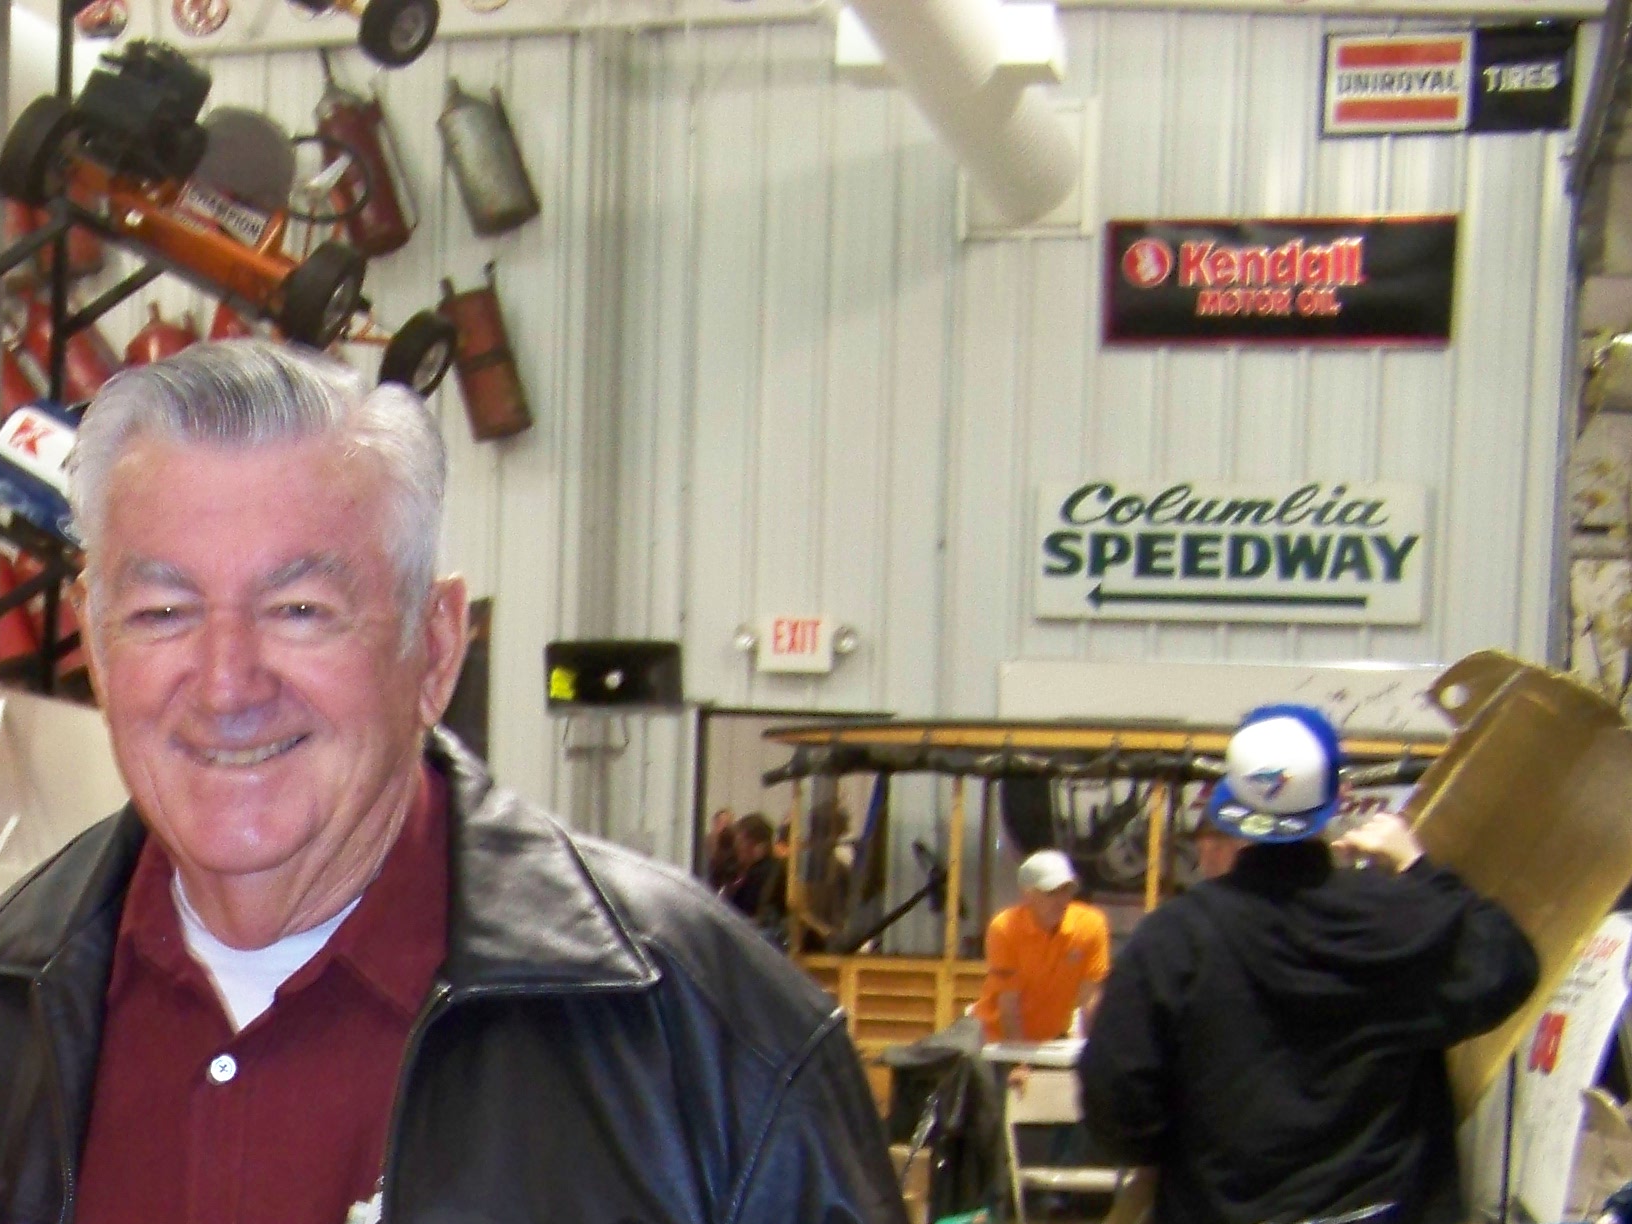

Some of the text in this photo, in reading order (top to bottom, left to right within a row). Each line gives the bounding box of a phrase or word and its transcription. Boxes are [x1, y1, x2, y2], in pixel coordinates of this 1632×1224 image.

[1336, 63, 1561, 96] UNIROYAL TIRES
[1178, 236, 1365, 287] Kendall
[1195, 286, 1343, 317] MOTOR OIL
[1059, 481, 1390, 528] Columbia
[1042, 530, 1419, 582] SPEEDWAY
[771, 617, 823, 656] EXIT
